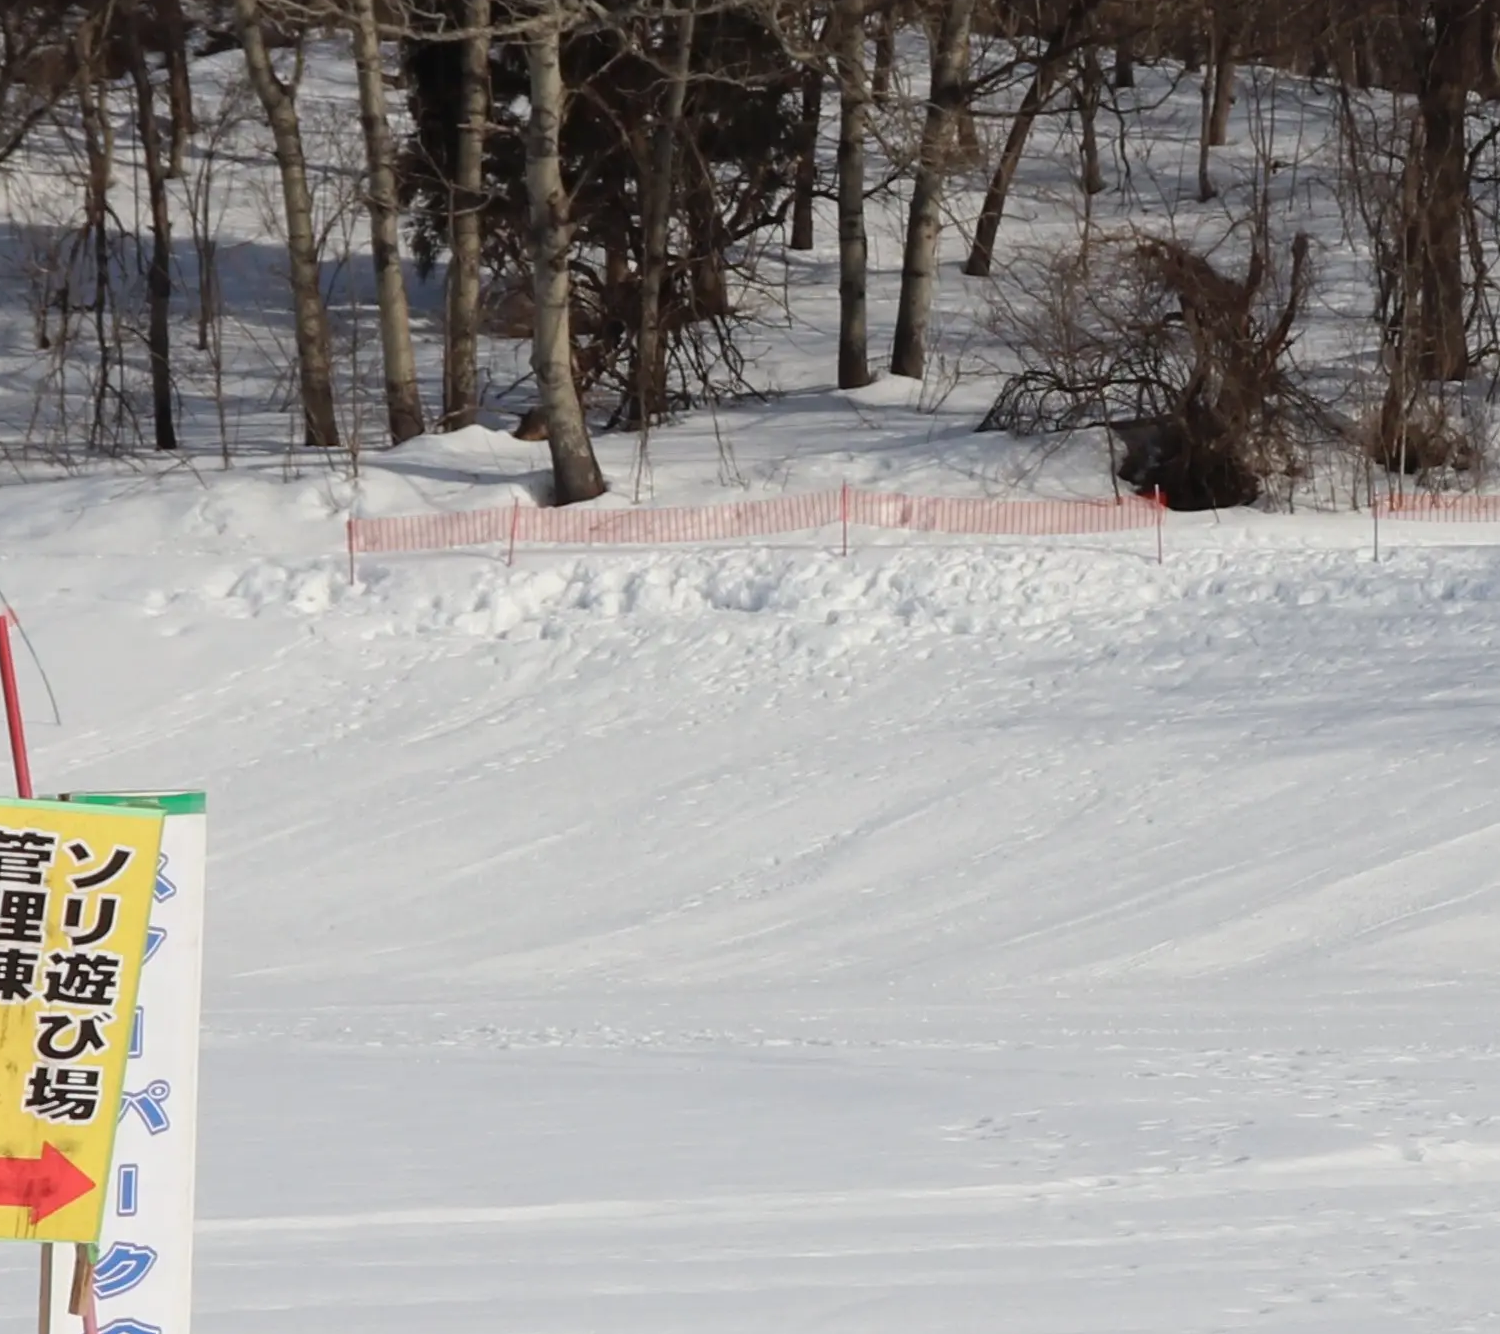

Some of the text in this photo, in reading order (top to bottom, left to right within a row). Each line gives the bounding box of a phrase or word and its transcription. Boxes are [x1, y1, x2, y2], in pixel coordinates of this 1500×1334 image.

[25, 841, 133, 1123] ソリ遊び場
